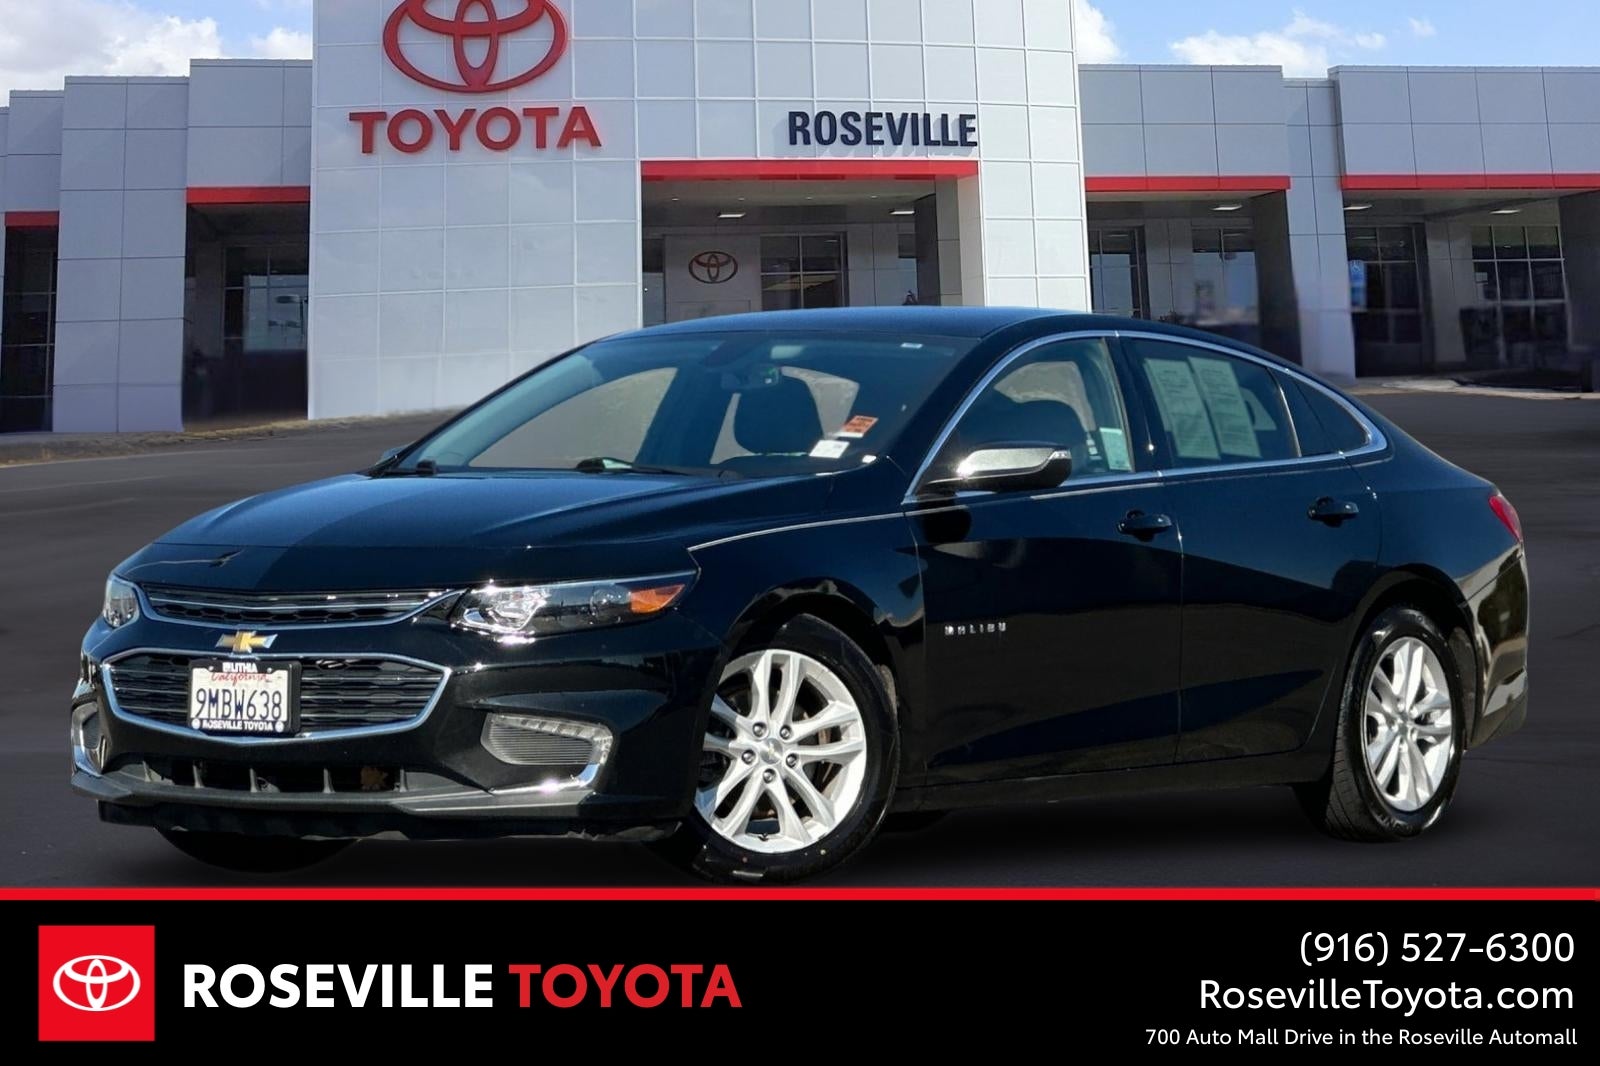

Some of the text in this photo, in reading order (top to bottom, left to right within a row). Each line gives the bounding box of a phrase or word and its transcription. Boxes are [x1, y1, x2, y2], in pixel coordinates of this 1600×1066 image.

[349, 106, 602, 154] TOYOTA
[788, 111, 978, 147] ROSEVILLE
[196, 688, 282, 720] 9MBW638
[202, 720, 273, 731] ROSEVILLE TOYOTA
